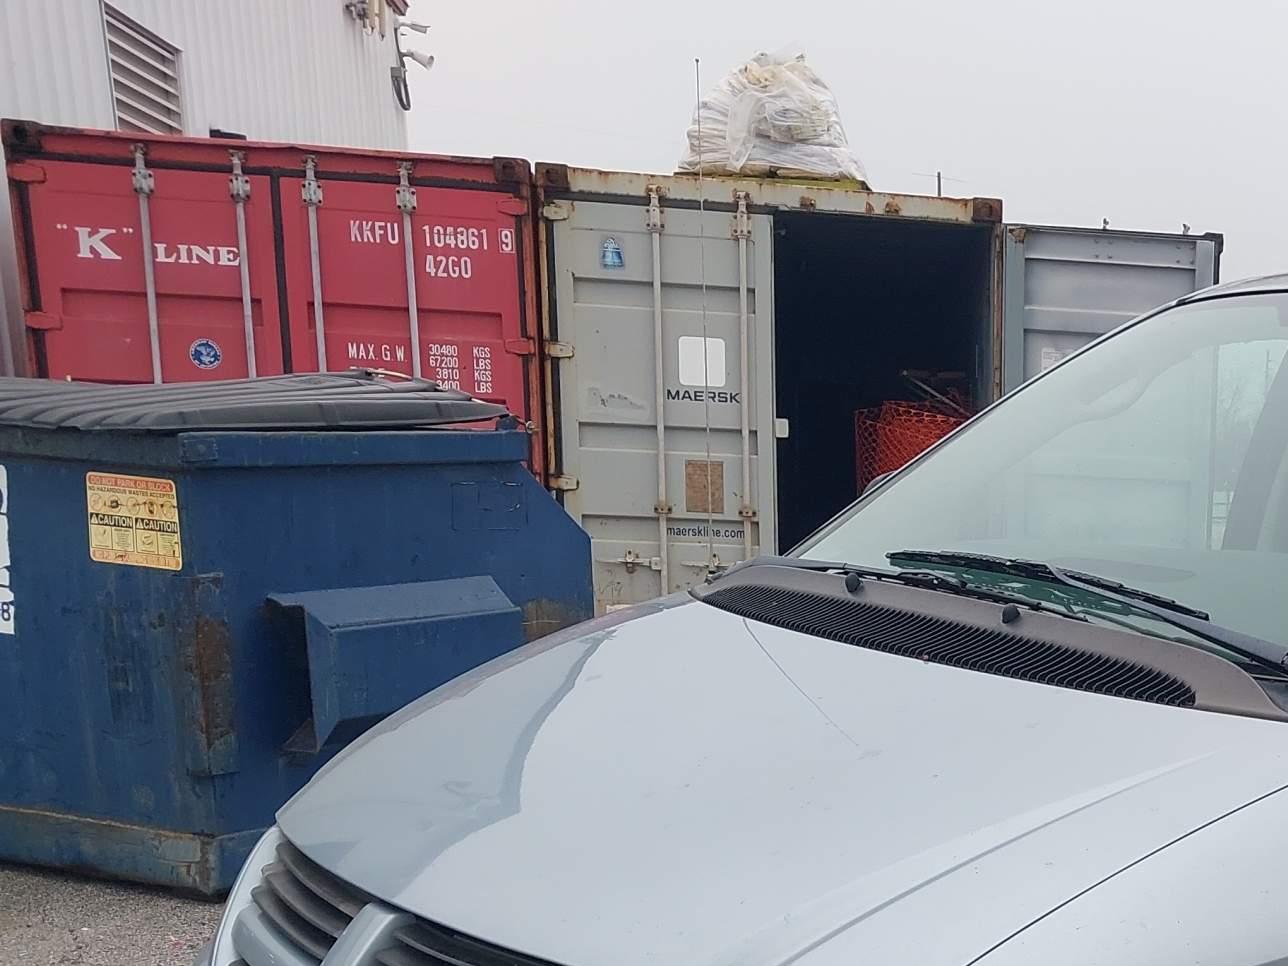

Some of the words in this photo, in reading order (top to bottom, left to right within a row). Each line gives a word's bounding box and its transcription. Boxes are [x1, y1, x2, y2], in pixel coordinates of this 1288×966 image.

[350, 219, 400, 245] KKFU
[422, 224, 488, 251] 104861
[501, 230, 512, 251] 9
[154, 243, 240, 266] LINE
[348, 342, 378, 361] MAX.
[428, 343, 458, 357] 30480
[473, 345, 491, 358] KGS
[429, 356, 459, 368] 67200
[473, 358, 491, 370] LBS
[436, 368, 460, 380] 3810
[474, 370, 492, 382] KGS
[475, 381, 492, 393] LBS
[666, 389, 742, 404] MAERSK
[101, 477, 115, 487] NOT
[117, 478, 135, 489] PARK
[136, 480, 147, 490] OR
[148, 481, 171, 492] BLOCK
[98, 514, 133, 527] CAUTION
[144, 519, 178, 532] CAUTION
